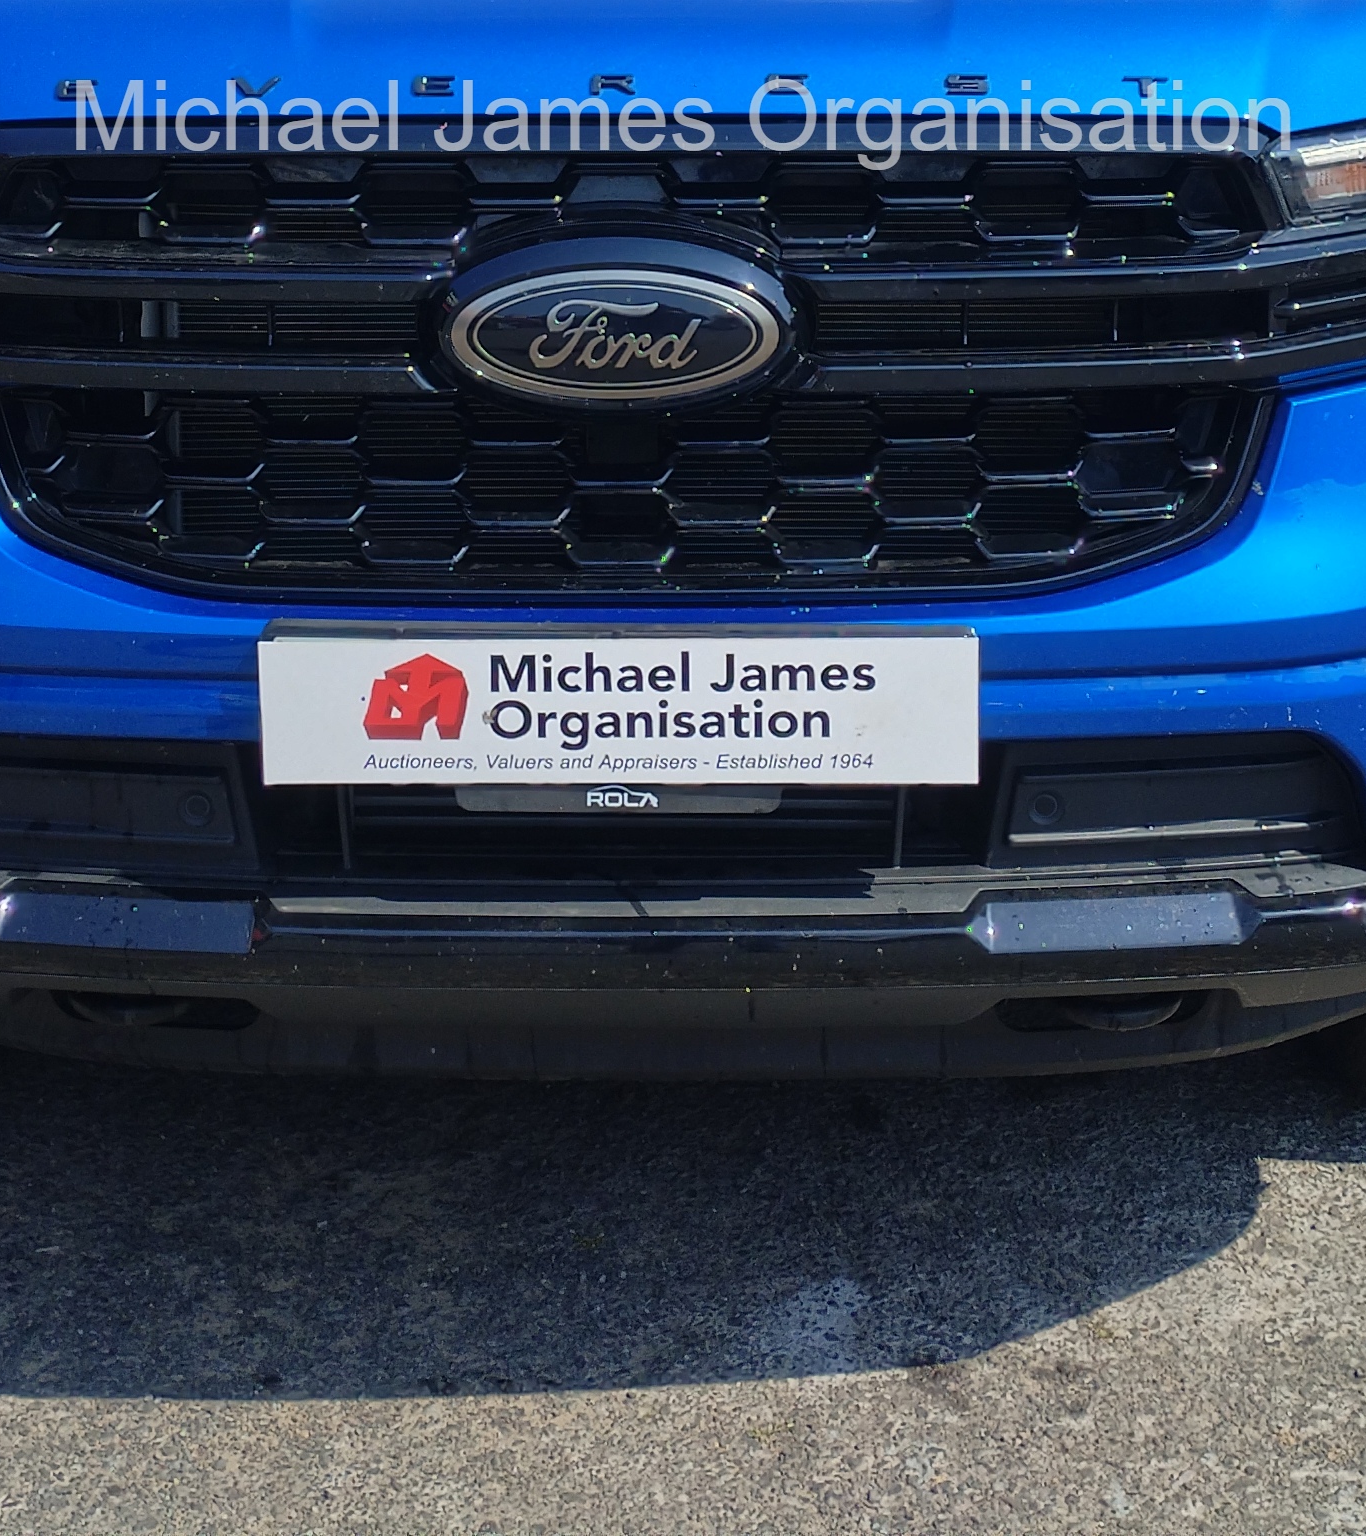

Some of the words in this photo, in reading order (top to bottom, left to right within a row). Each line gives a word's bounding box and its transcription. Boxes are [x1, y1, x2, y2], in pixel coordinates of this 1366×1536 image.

[529, 299, 704, 370] Ford
[490, 652, 690, 693] Michael
[710, 653, 877, 693] James
[490, 699, 832, 750] Organisation
[363, 753, 477, 771] Auctioneers,
[486, 754, 554, 770] Valuers
[560, 754, 594, 770] and
[598, 754, 697, 773] Appraisers
[716, 753, 823, 770] Established
[829, 753, 874, 770] 1964
[586, 791, 659, 808] ROLA
